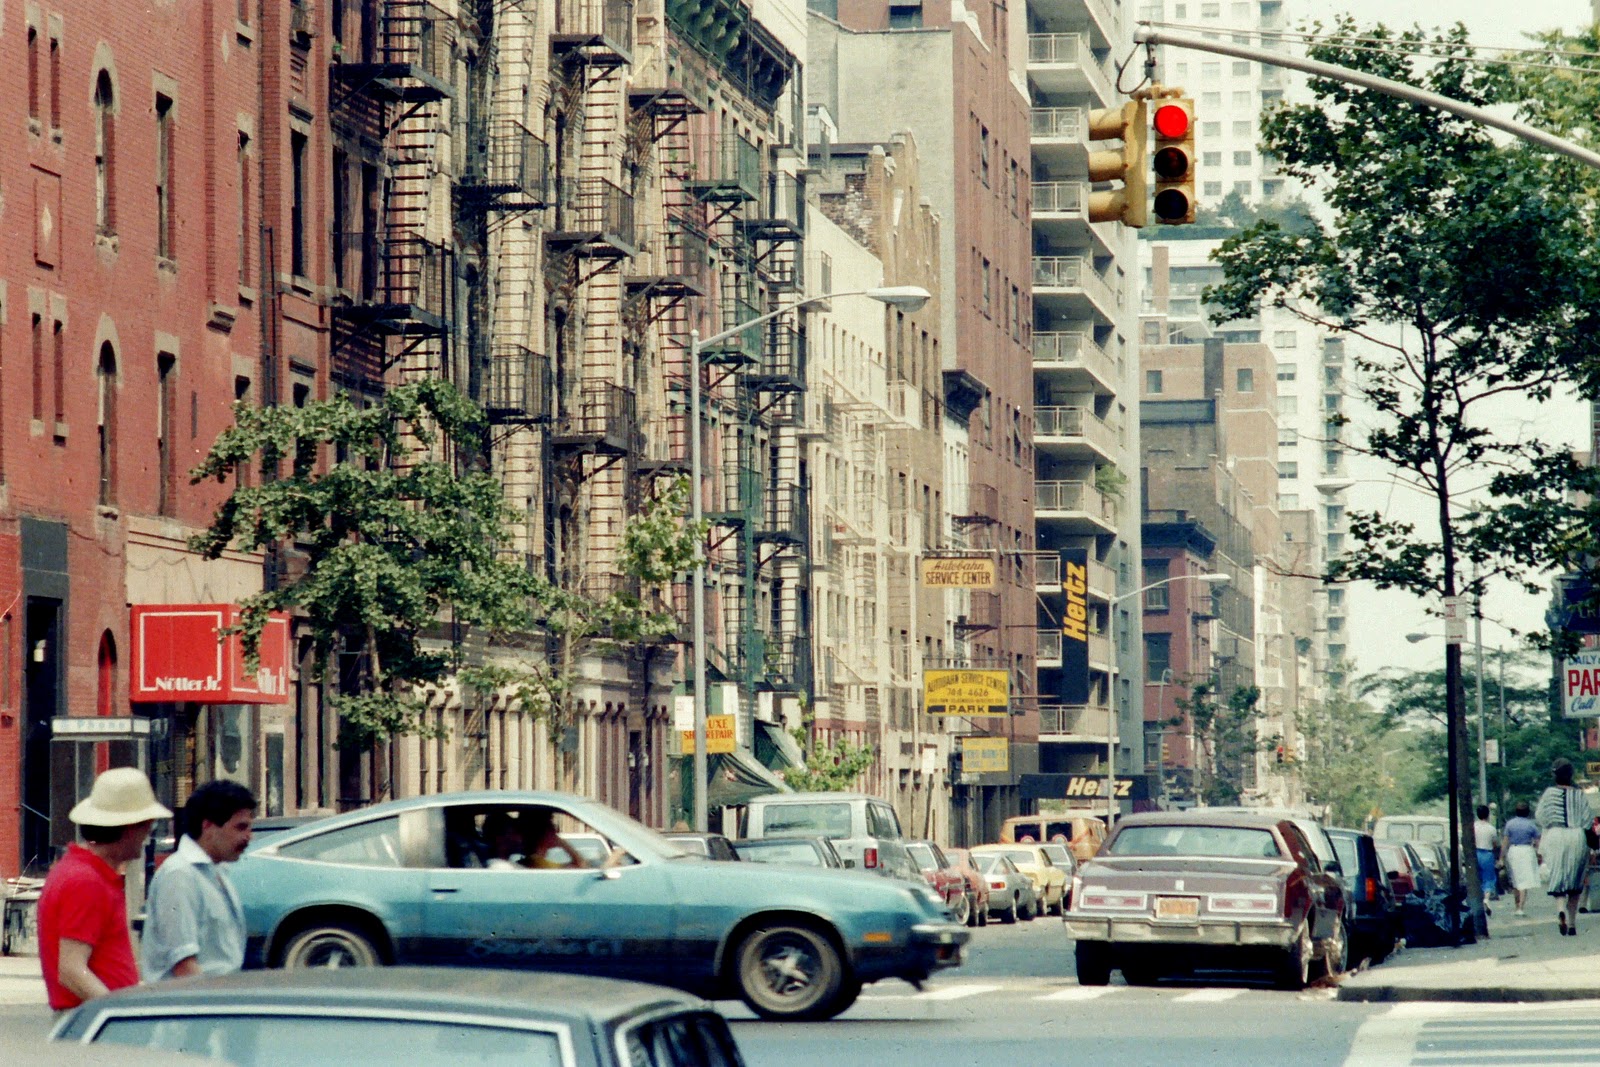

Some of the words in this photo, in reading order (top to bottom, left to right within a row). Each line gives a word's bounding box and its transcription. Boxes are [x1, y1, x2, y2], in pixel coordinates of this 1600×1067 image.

[925, 572, 960, 584] SERVICE
[962, 572, 991, 584] CENTER
[1063, 561, 1086, 642] Hertz
[928, 674, 958, 692] AUTOBAHN
[961, 673, 984, 684] SERVICE
[986, 676, 1006, 695] CENTER
[948, 705, 985, 713] PARK
